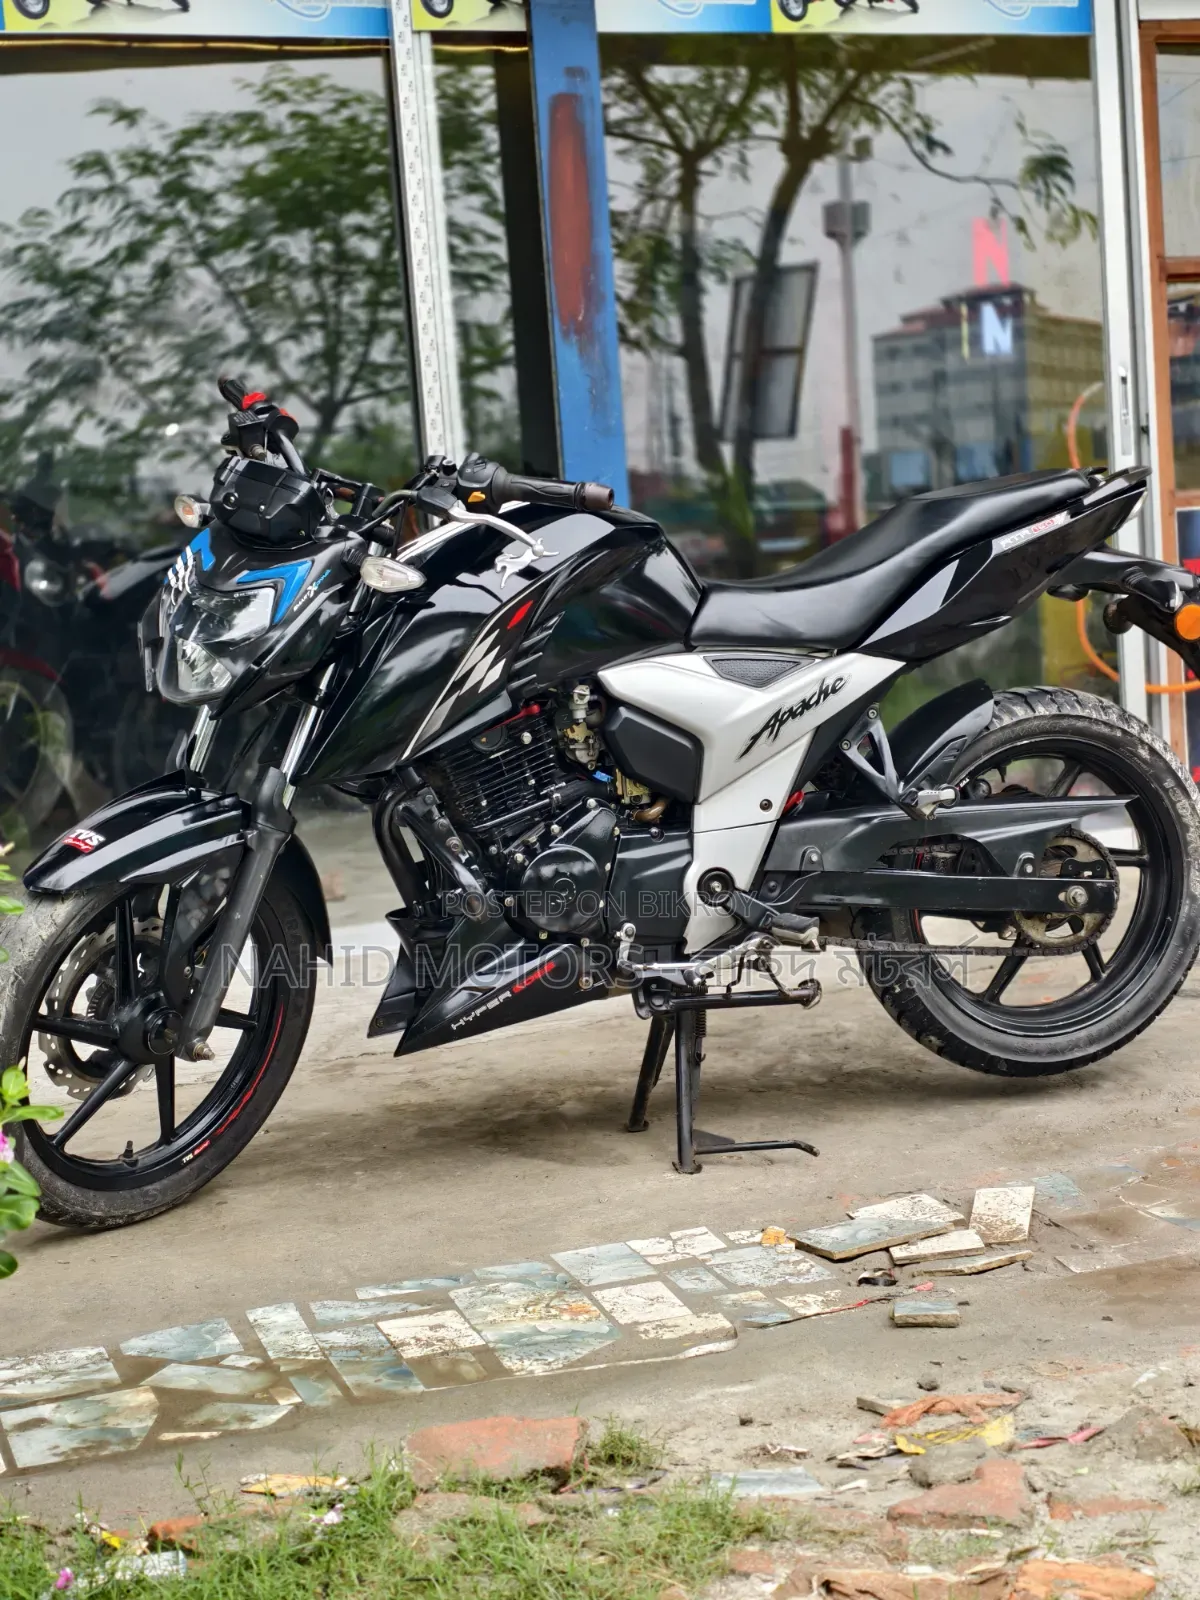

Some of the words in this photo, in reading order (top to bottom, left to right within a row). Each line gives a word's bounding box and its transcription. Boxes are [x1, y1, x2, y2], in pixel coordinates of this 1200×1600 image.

[735, 674, 848, 762] Apache
[67, 828, 106, 846] TVS
[451, 990, 512, 1031] HYPER
